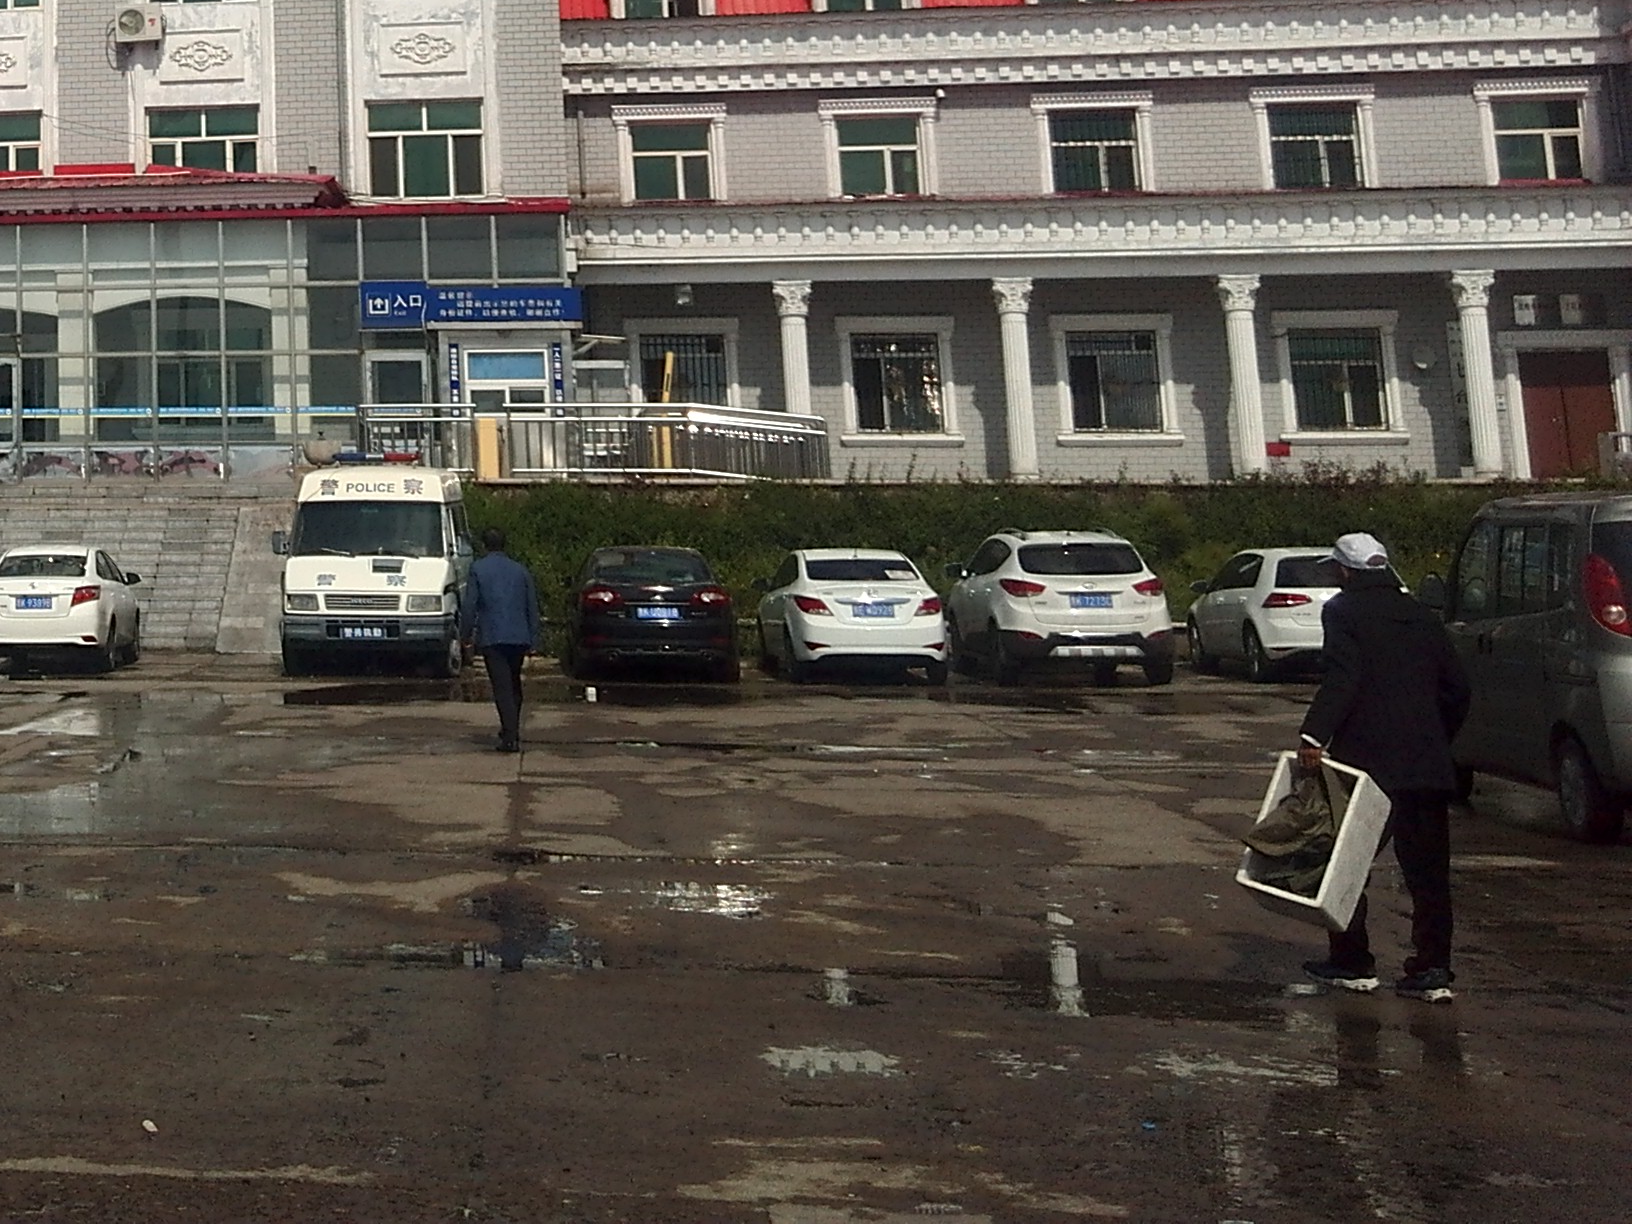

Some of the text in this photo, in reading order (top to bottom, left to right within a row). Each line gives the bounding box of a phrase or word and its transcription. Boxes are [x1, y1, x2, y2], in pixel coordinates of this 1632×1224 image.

[393, 294, 423, 308] 入口
[320, 478, 424, 496] 警 POLICE 察
